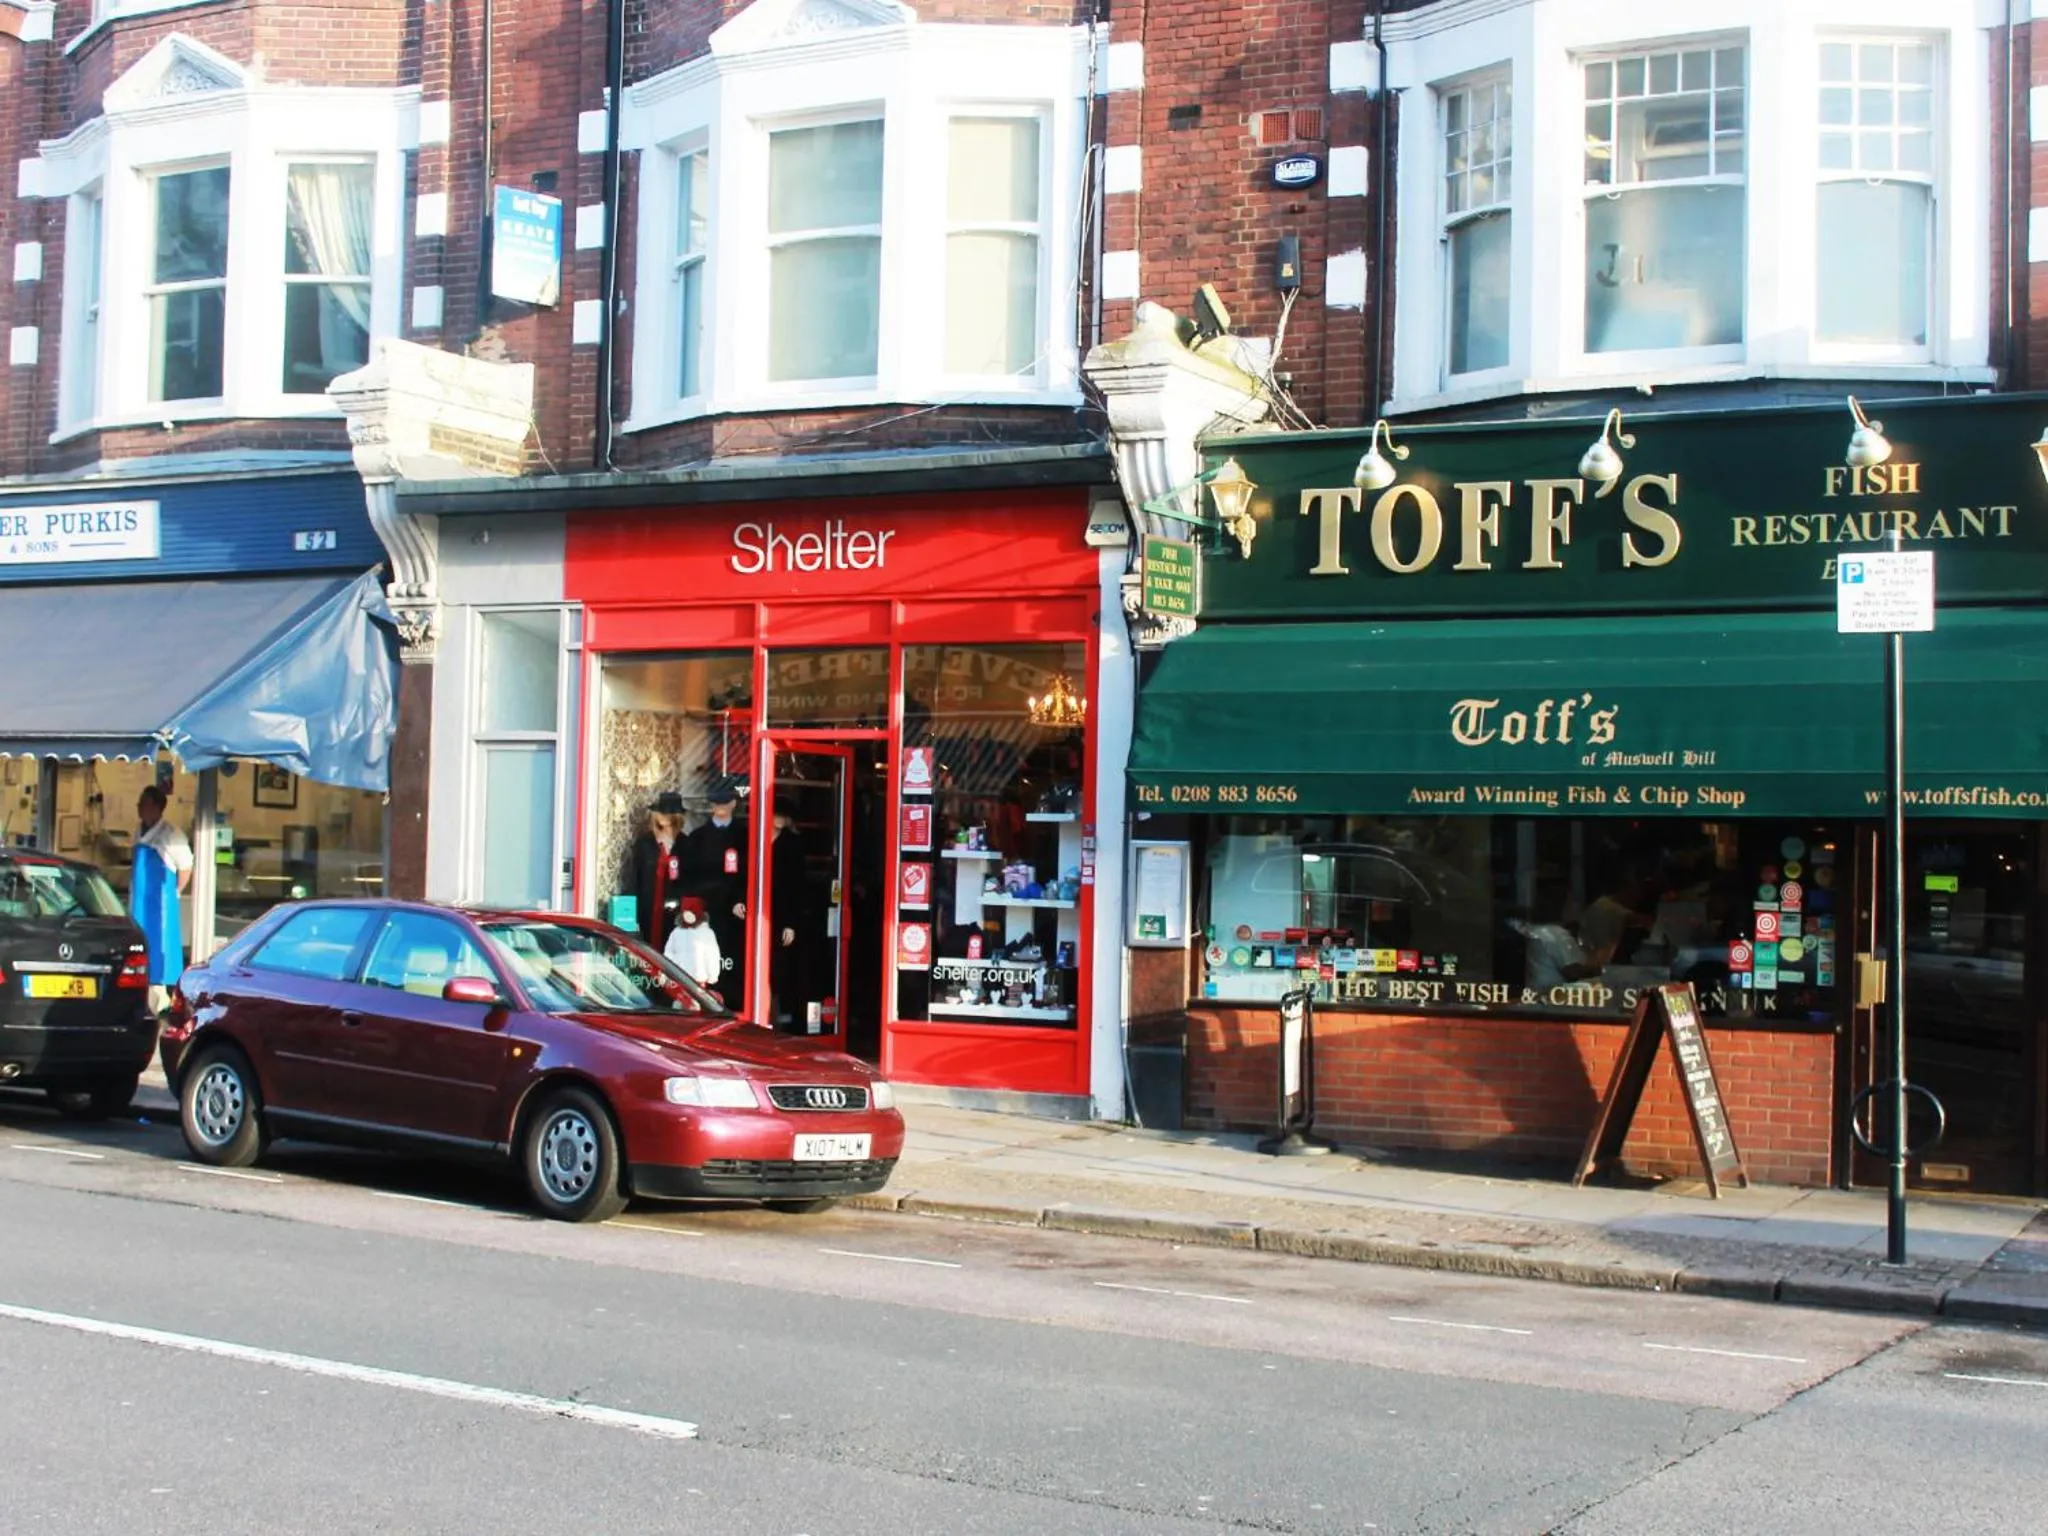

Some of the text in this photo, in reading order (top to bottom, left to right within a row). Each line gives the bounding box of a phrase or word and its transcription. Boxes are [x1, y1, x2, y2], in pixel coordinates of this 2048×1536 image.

[1824, 463, 1921, 496] FISH
[45, 510, 138, 535] PURKIS
[1300, 472, 1681, 575] TOFF'S
[1732, 506, 2018, 546] RESTAURANT
[26, 541, 59, 553] SONS
[730, 519, 895, 574] Shelter
[1450, 692, 1619, 747] Toff's
[1581, 750, 1716, 767] of Muswell Hill
[1136, 785, 1298, 803] Tel. 0208 883 8656
[1407, 785, 1746, 809] Award Winning Fish & Chip Shop
[1864, 786, 2048, 807] ww.toffsfish.co.
[932, 966, 1038, 986] shelter.org.uk
[1331, 979, 1377, 998] THE
[1388, 980, 1444, 1001] BEST
[1455, 982, 1510, 1004] FISH
[1550, 987, 1614, 1009] CHIP
